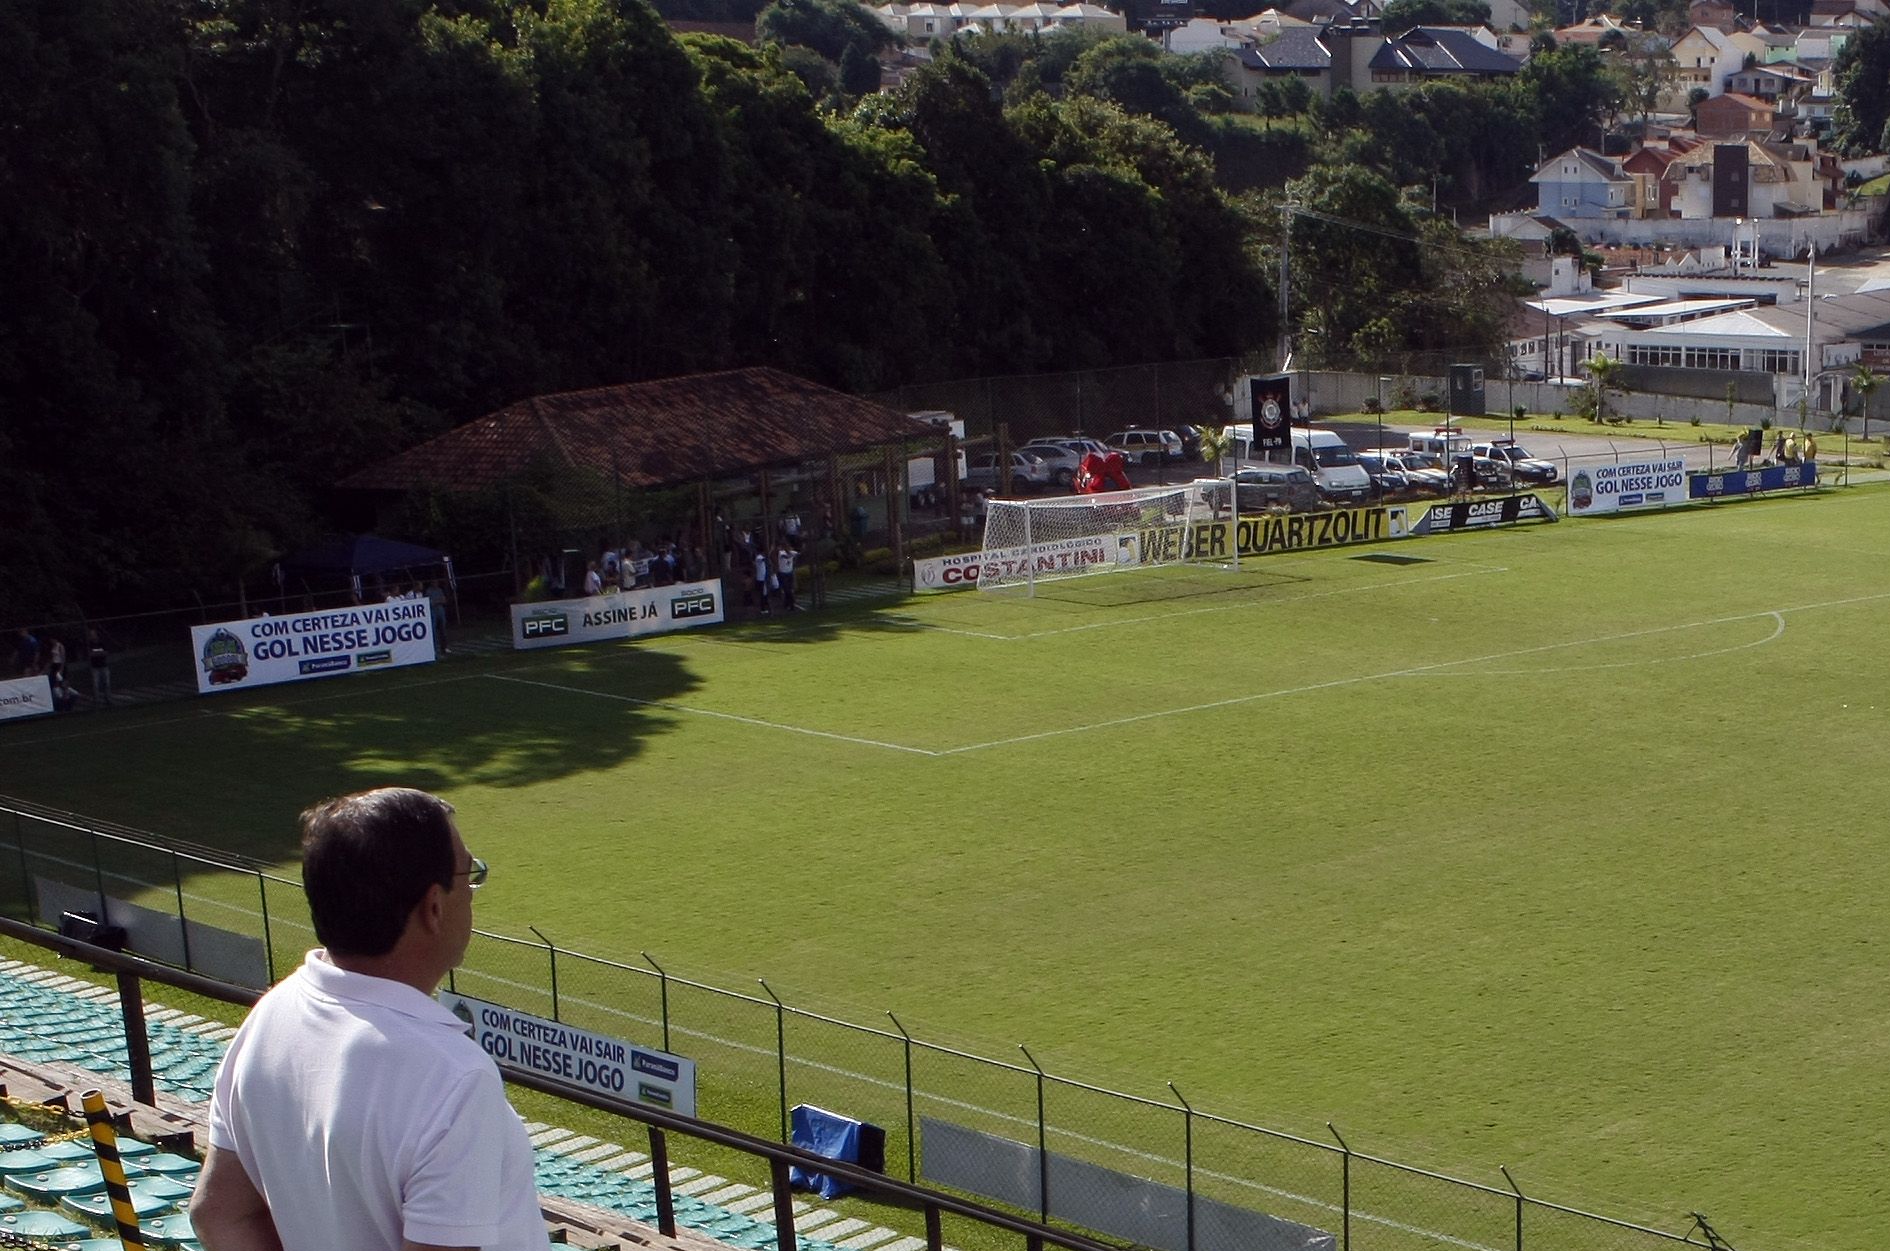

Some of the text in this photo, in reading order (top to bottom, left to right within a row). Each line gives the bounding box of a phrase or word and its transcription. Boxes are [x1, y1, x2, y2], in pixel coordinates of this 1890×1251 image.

[1596, 460, 1683, 479] COM CERTEZA VAI SAIR
[1596, 473, 1683, 494] GOL NESSE JOGO
[1469, 501, 1504, 517] CASE
[1140, 523, 1228, 563] WEBER
[1236, 508, 1386, 554] QUARTZOLIT
[942, 548, 1105, 584] COSTANTINI
[251, 603, 426, 638] COM CERTEZA VAI SAIR
[583, 601, 658, 628] ASSINE JÁ
[674, 598, 712, 615] PFC
[253, 639, 300, 661] GOL
[302, 628, 369, 656] NESSE
[371, 620, 427, 646] JOGO
[525, 618, 565, 635] PFC
[481, 1008, 626, 1064] COM CERTEZA VAI SAIR
[481, 1032, 625, 1092] GOL NESSE JOGO
